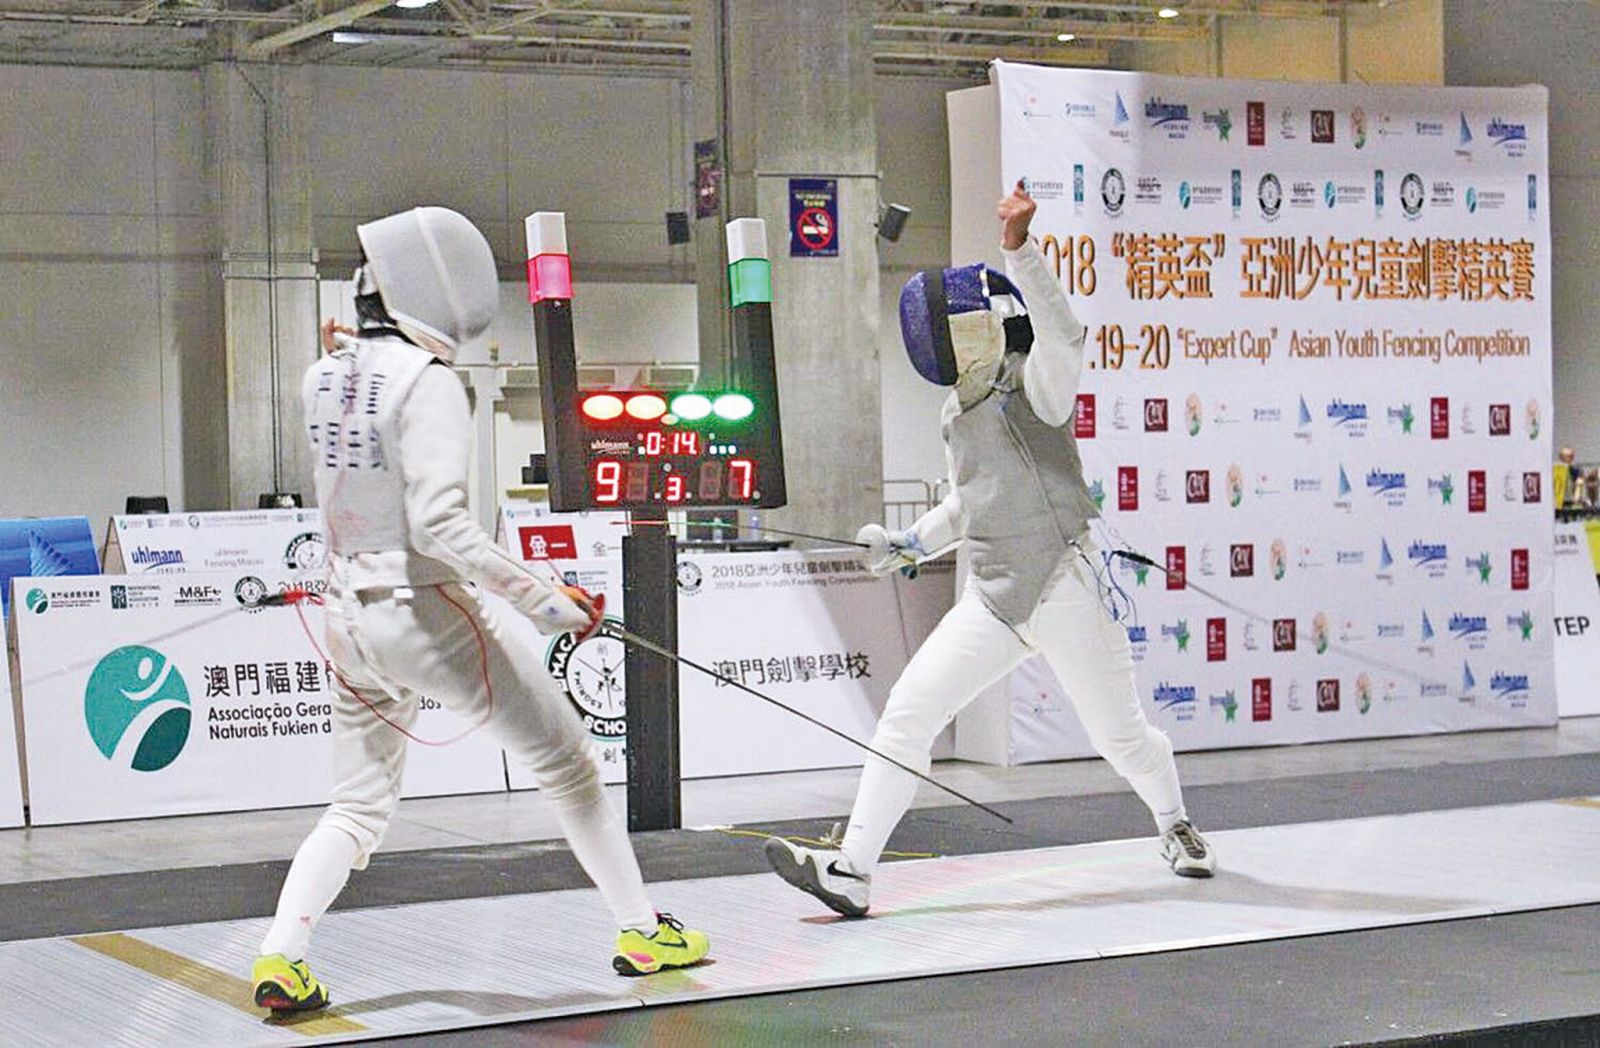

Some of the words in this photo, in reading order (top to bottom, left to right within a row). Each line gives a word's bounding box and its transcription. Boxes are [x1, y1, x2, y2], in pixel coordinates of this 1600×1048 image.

[1288, 330, 1331, 358] Asian
[1334, 329, 1379, 358] Youth
[1382, 329, 1441, 364] Fencing
[1444, 330, 1531, 365] Competition
[597, 462, 620, 501] 9
[666, 477, 681, 500] 3
[730, 460, 751, 498] 7
[131, 545, 184, 564] uhlmann
[204, 660, 331, 698] 澳門福建
[207, 702, 293, 722] Associação
[209, 722, 268, 740] Naturais
[272, 719, 318, 735] Fukien
